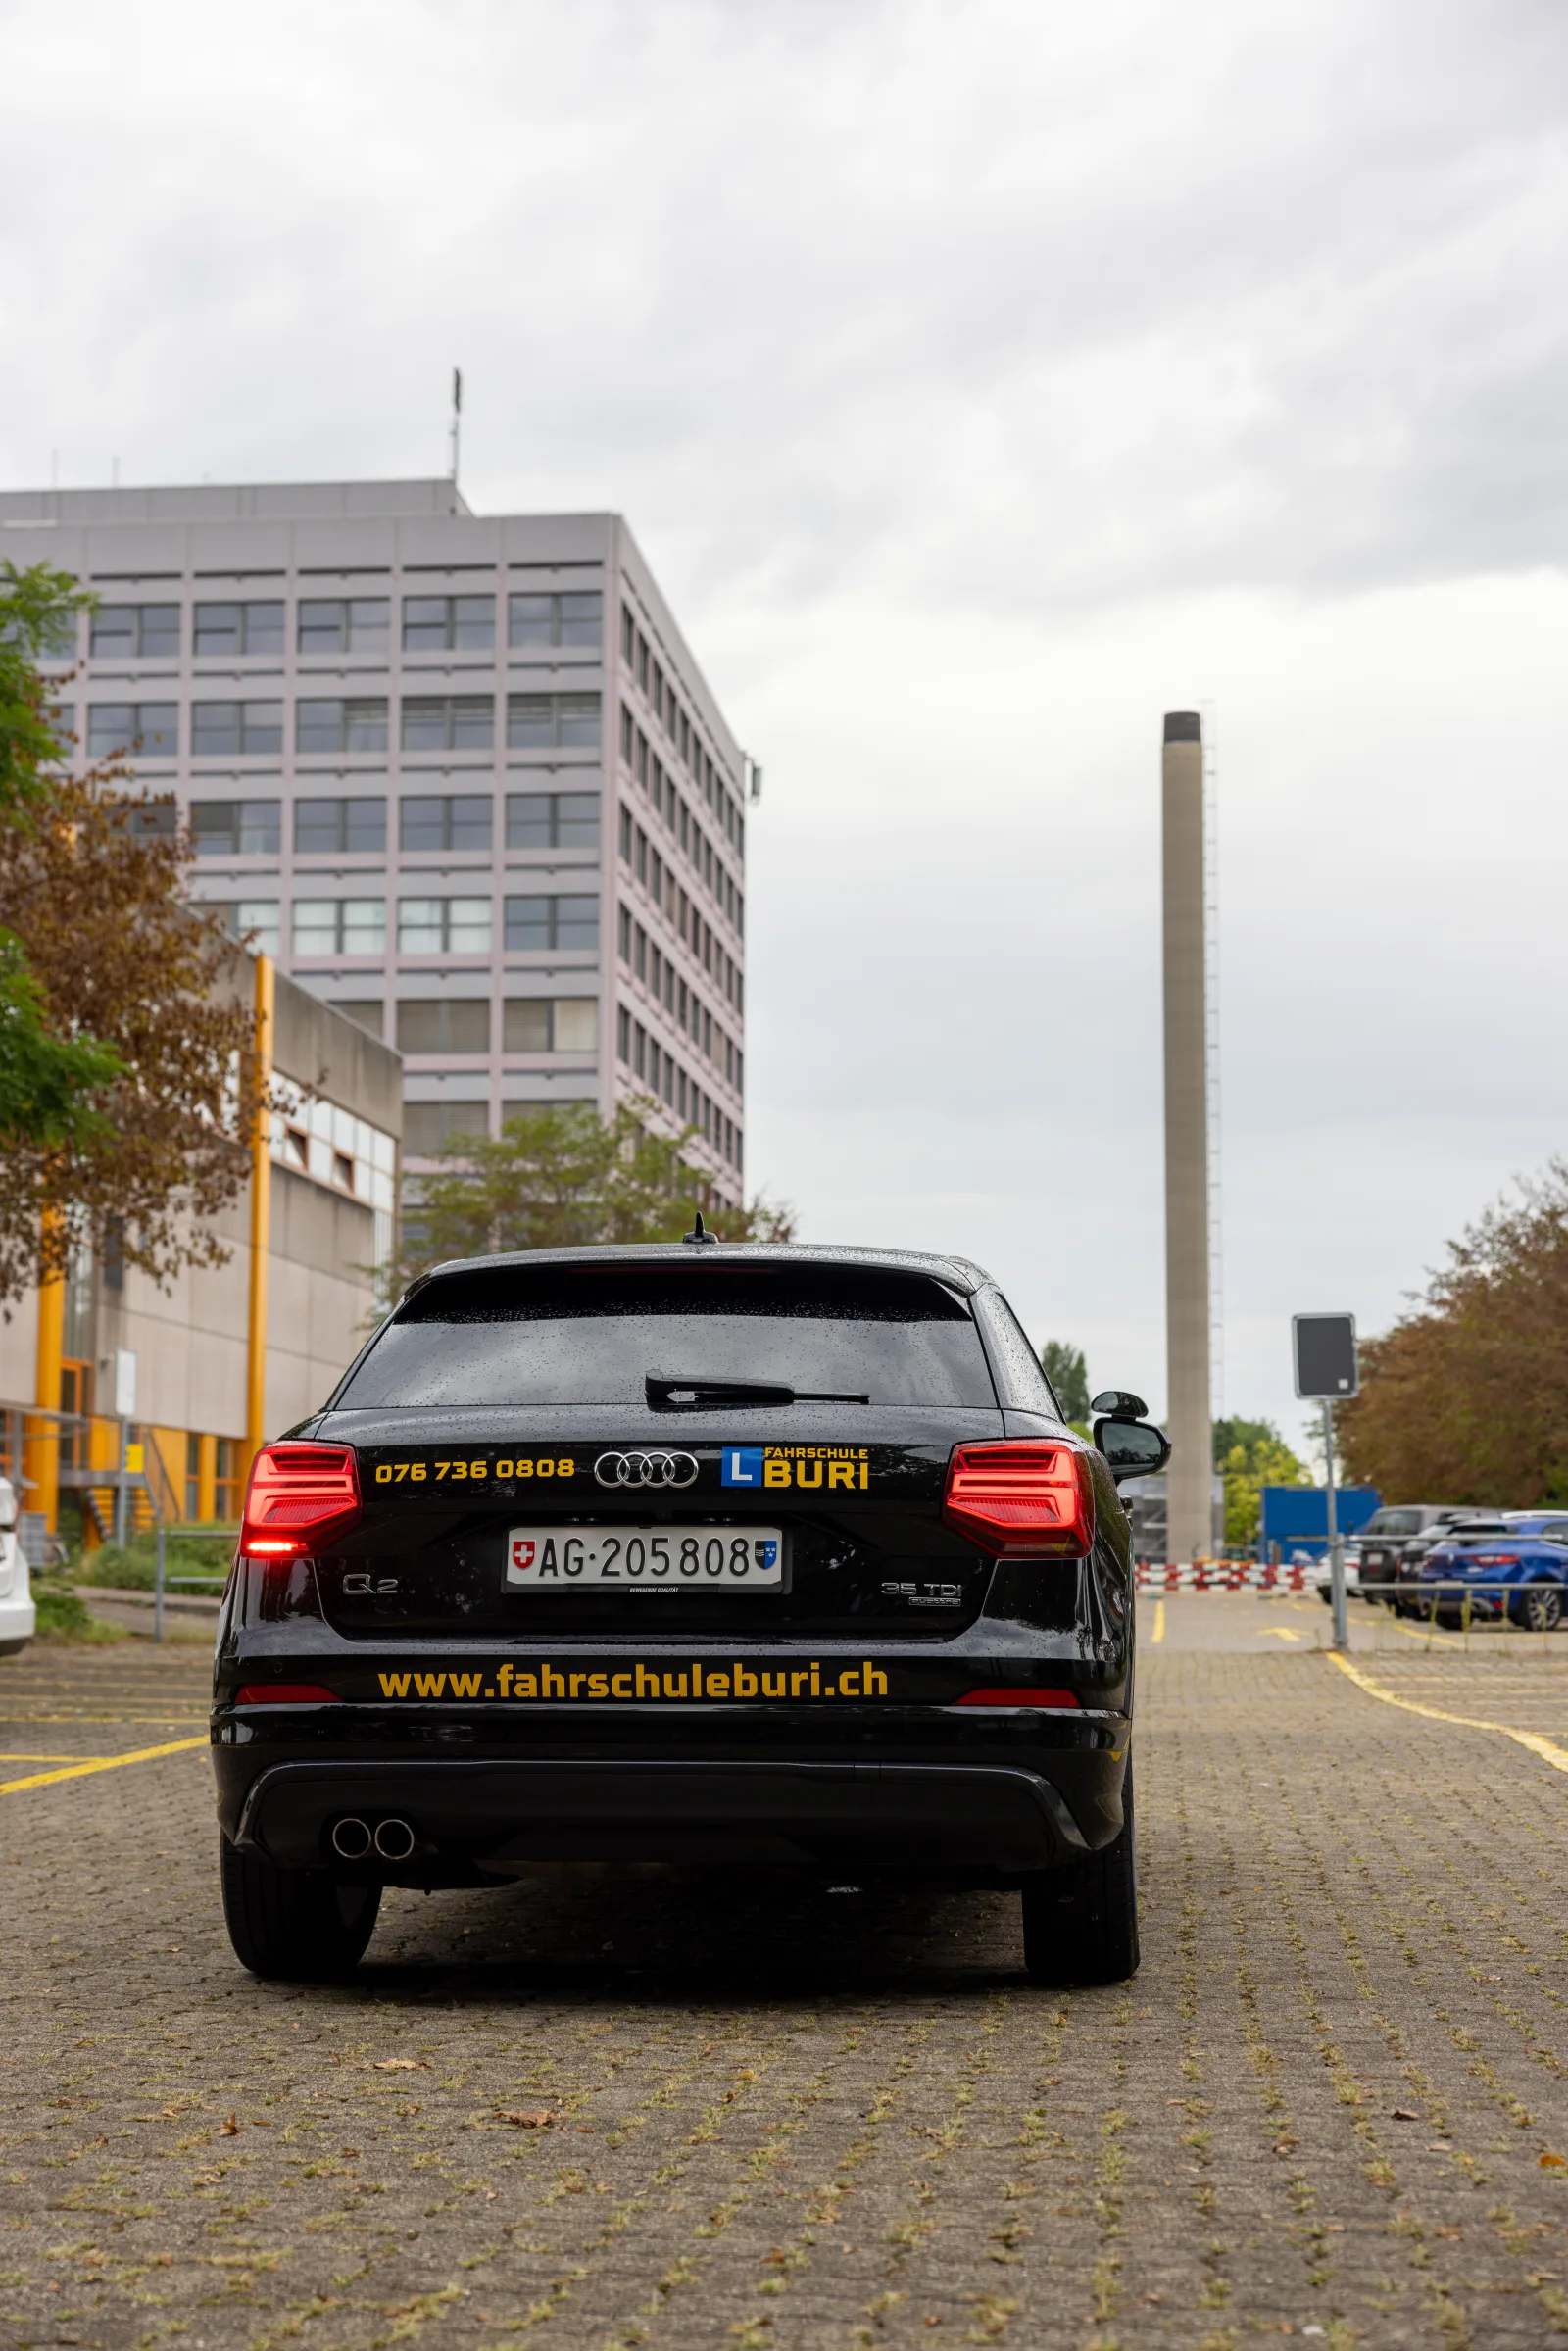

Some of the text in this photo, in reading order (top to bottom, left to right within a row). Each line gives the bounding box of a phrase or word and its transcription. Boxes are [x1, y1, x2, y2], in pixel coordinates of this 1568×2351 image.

[764, 1447, 869, 1459] FAHRSCHULE
[375, 1459, 575, 1483] 076 736 0808
[731, 1452, 753, 1481] L
[764, 1459, 869, 1490] BURI
[343, 1573, 399, 1594] Q2
[881, 1582, 962, 1597] 35 TDI
[378, 1661, 889, 1698] www.fahrschuleburi.ch
